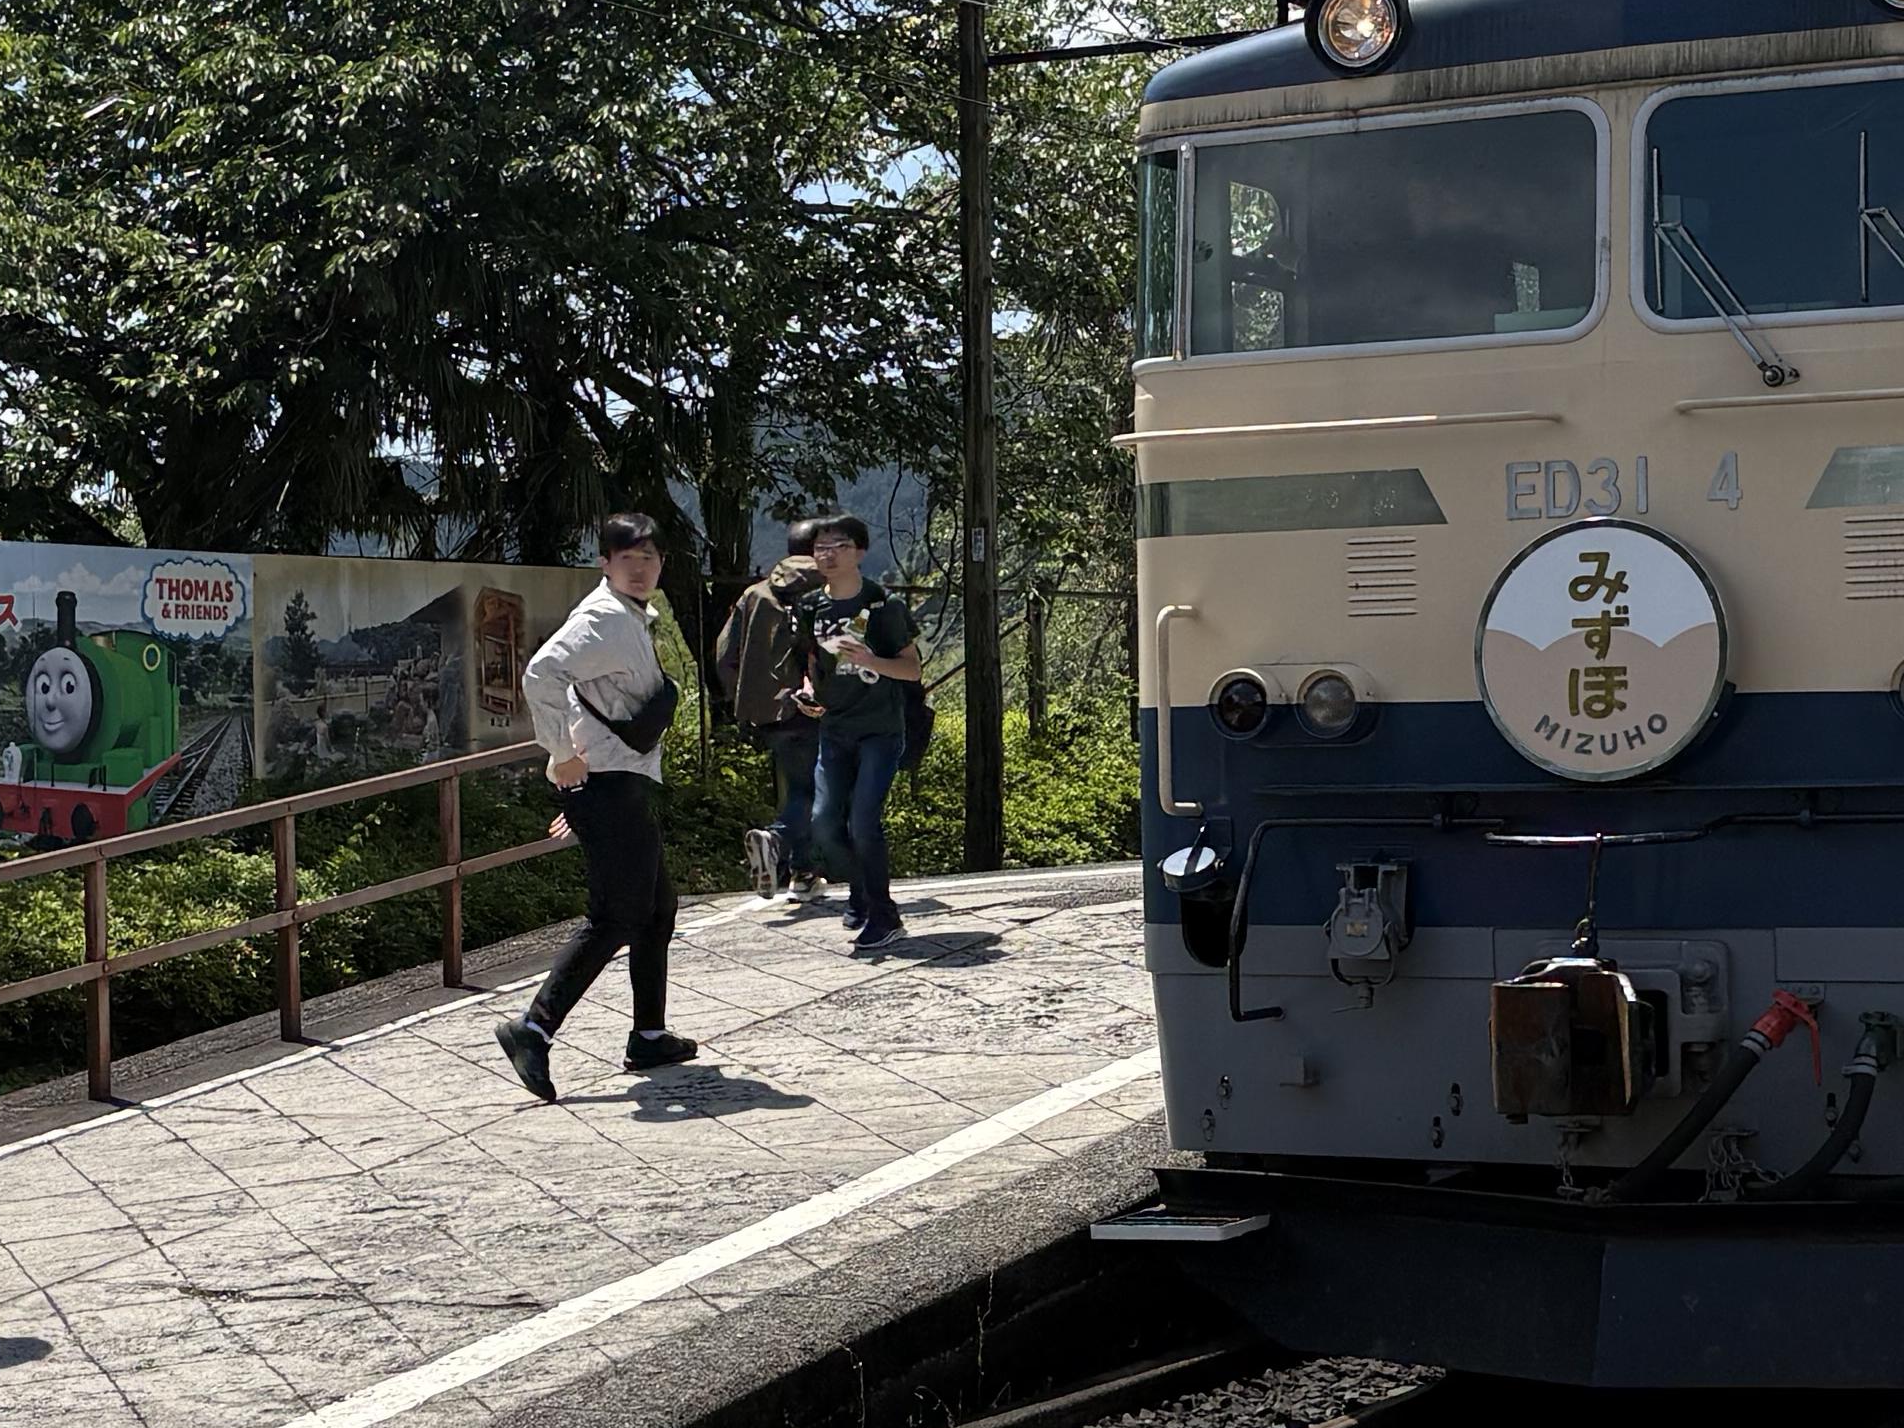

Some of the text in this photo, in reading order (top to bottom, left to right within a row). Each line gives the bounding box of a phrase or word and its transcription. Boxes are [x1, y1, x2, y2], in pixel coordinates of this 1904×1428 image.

[1505, 451, 1744, 521] ED31 4
[155, 578, 234, 603] THOMAS
[161, 602, 229, 621] & FRIENDS
[1568, 551, 1630, 719] みずほ
[1535, 713, 1668, 756] MIZUHO
